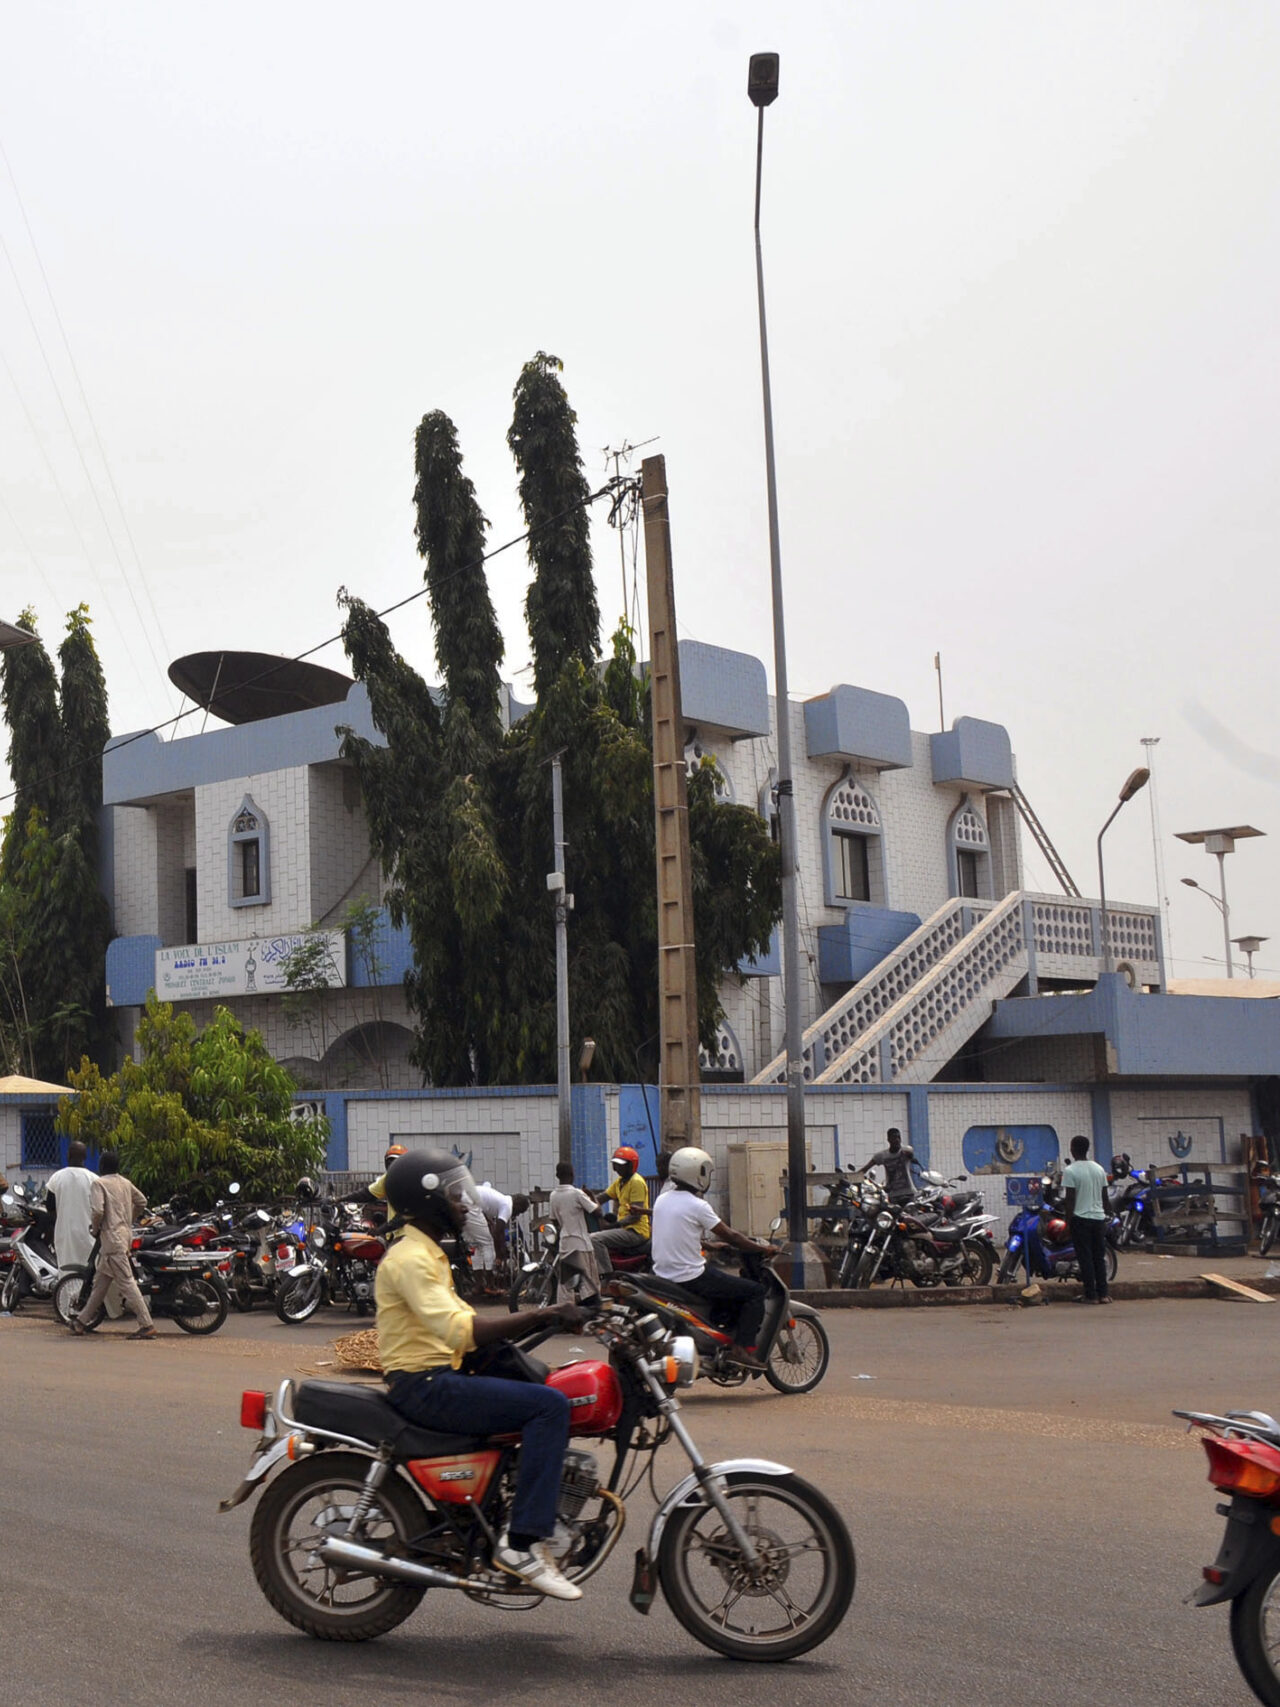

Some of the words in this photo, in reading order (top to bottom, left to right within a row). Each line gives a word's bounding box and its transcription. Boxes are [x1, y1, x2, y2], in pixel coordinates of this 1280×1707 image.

[161, 951, 170, 961] LA
[173, 949, 190, 960] VOIX
[194, 947, 205, 958] DE
[207, 943, 240, 956] L'ISLAM
